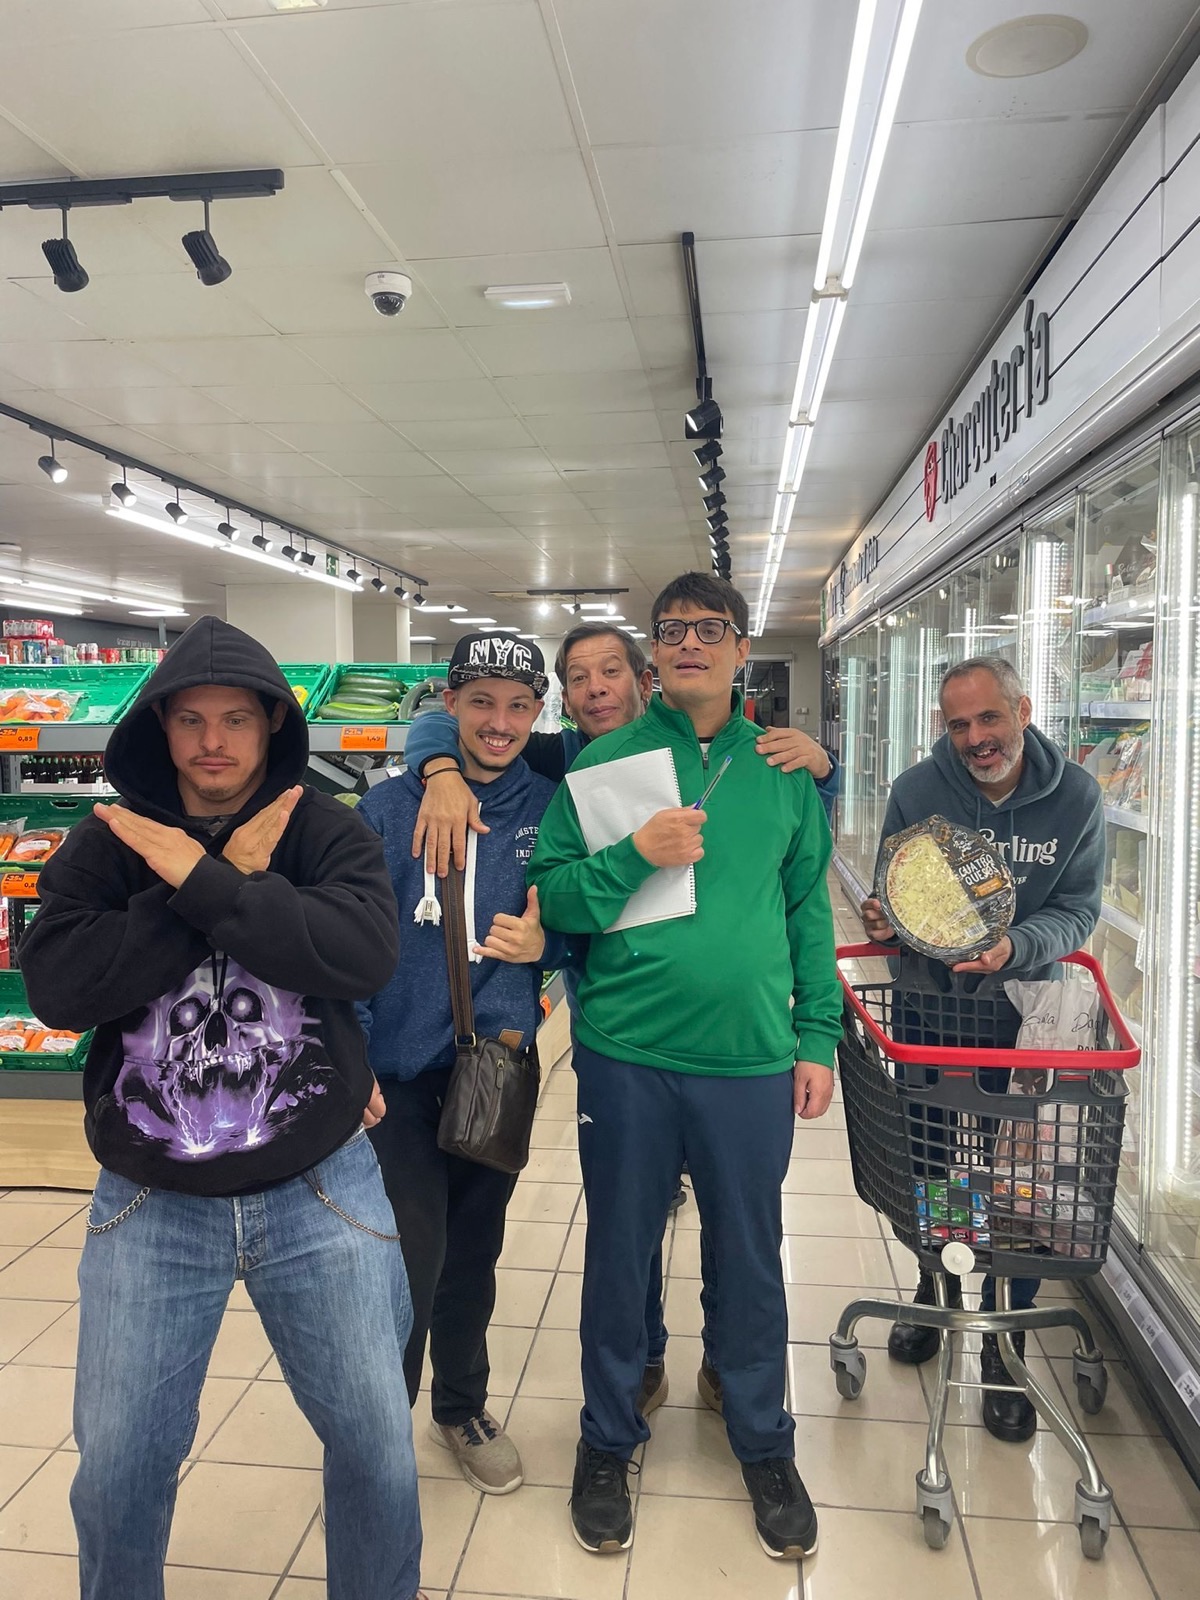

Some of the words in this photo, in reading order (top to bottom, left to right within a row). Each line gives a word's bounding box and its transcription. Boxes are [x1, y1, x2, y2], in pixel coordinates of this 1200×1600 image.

[941, 299, 1050, 504] Charcutería
[469, 637, 532, 670] NYC
[515, 826, 539, 841] AMSTE
[958, 853, 994, 878] CUATRO
